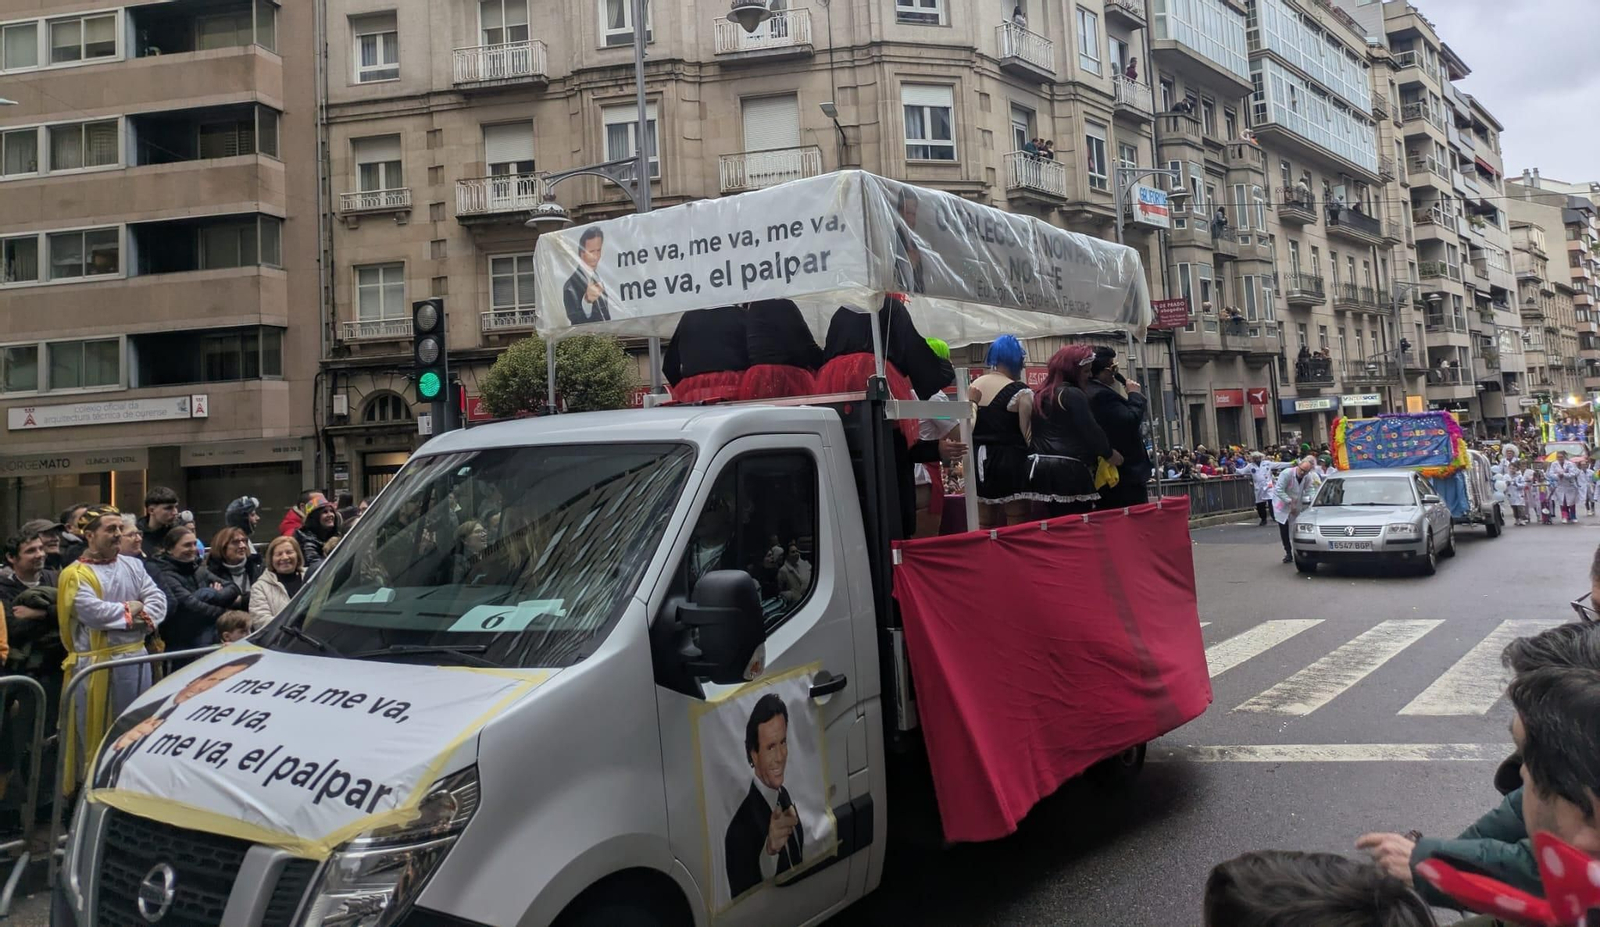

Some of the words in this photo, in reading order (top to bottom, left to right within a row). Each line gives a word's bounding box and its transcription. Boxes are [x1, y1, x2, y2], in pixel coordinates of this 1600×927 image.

[617, 246, 648, 268] me
[654, 243, 684, 262] va,
[689, 234, 722, 257] me
[728, 229, 760, 248] va,
[767, 219, 803, 243] me
[810, 214, 846, 235] va,
[620, 278, 657, 301] me
[664, 273, 701, 294] va,
[709, 260, 732, 288] el
[741, 248, 831, 290] palpar
[1012, 286, 1044, 309] Gaego
[43, 413, 90, 424] arquitectura
[92, 410, 121, 421] técnica
[124, 410, 134, 419] de
[136, 408, 168, 419] ourense
[74, 405, 101, 414] colexio
[104, 401, 125, 412] oficial
[128, 401, 139, 410] da
[481, 610, 516, 629] 6
[225, 677, 274, 696] me
[272, 680, 310, 705] va,
[310, 687, 367, 710] me
[367, 695, 412, 724] va,
[185, 703, 232, 723] me
[231, 709, 271, 733] va,
[146, 730, 195, 757] me
[193, 737, 233, 770] va,
[237, 745, 283, 775] el
[265, 756, 393, 814] palpar
